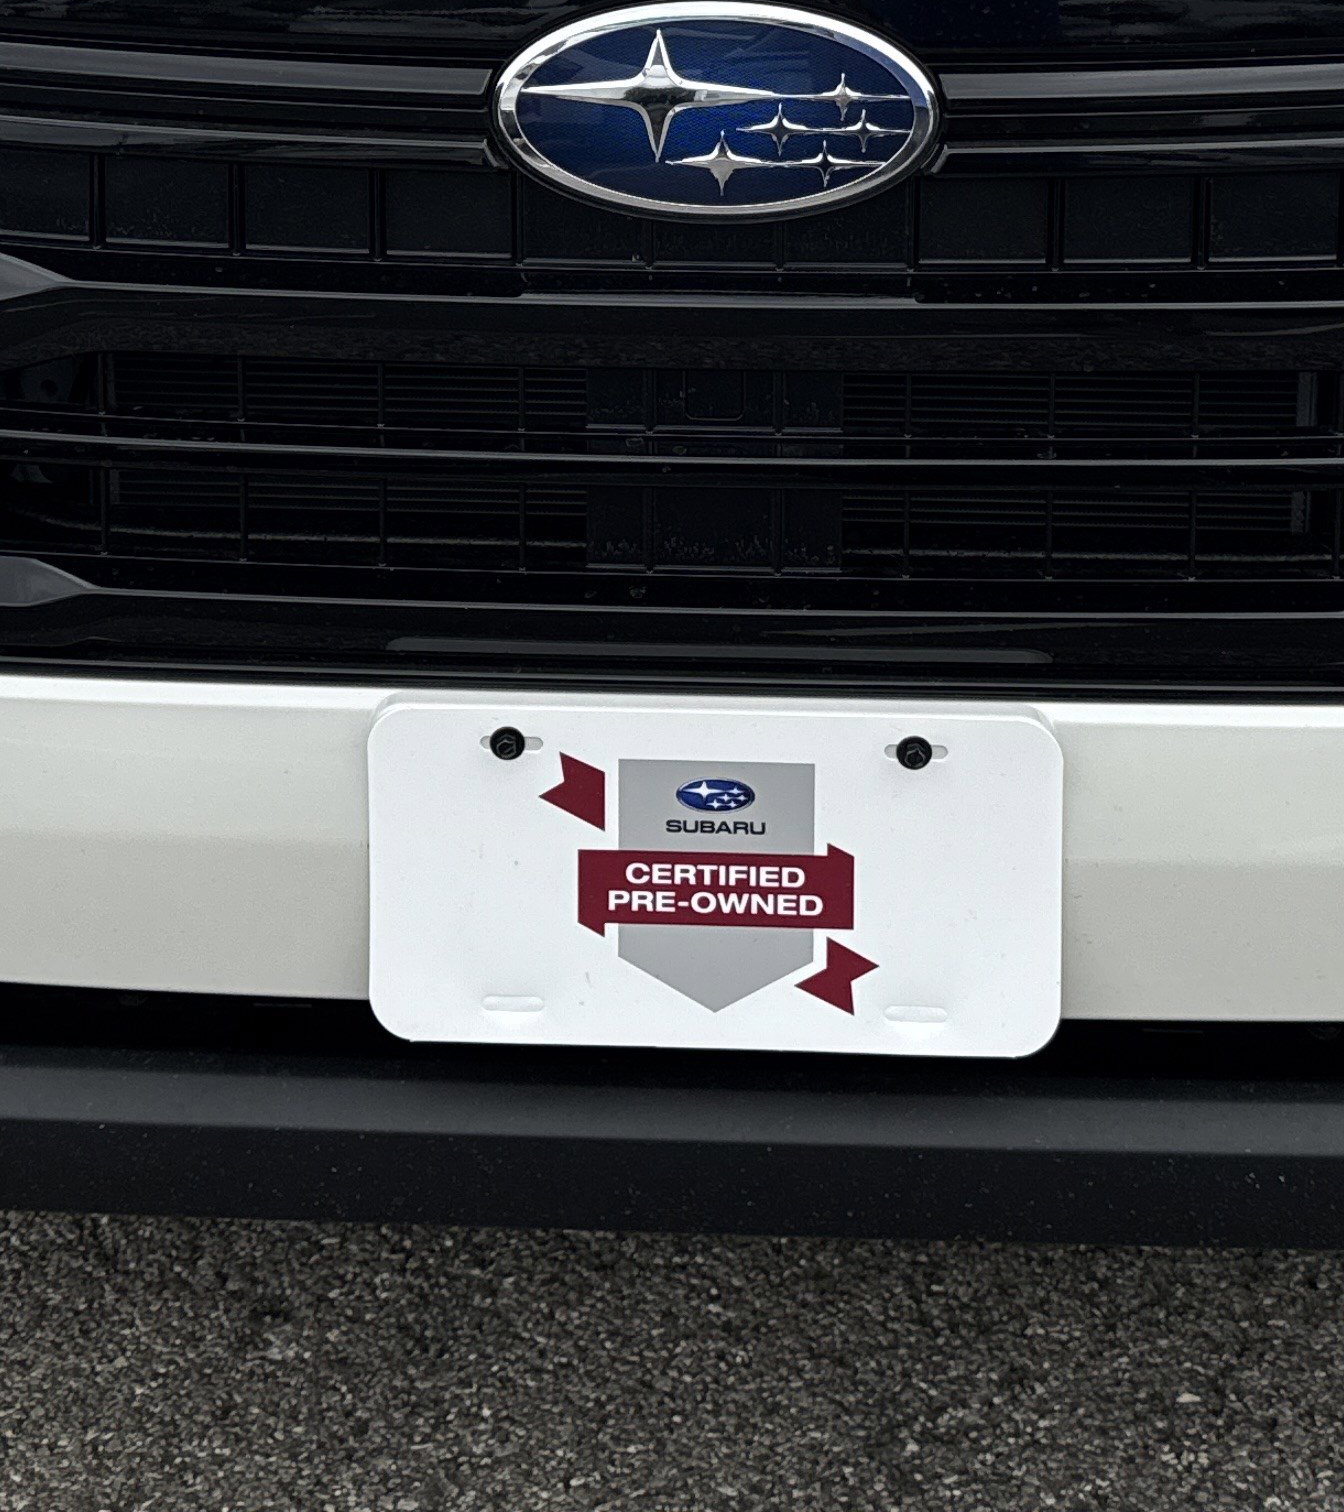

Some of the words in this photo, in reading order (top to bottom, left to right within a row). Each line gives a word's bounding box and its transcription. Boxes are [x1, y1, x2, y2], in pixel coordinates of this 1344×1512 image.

[665, 819, 766, 835] SUBARU
[625, 862, 805, 888] CERTIFIED
[608, 890, 824, 916] PRE-OWNED
